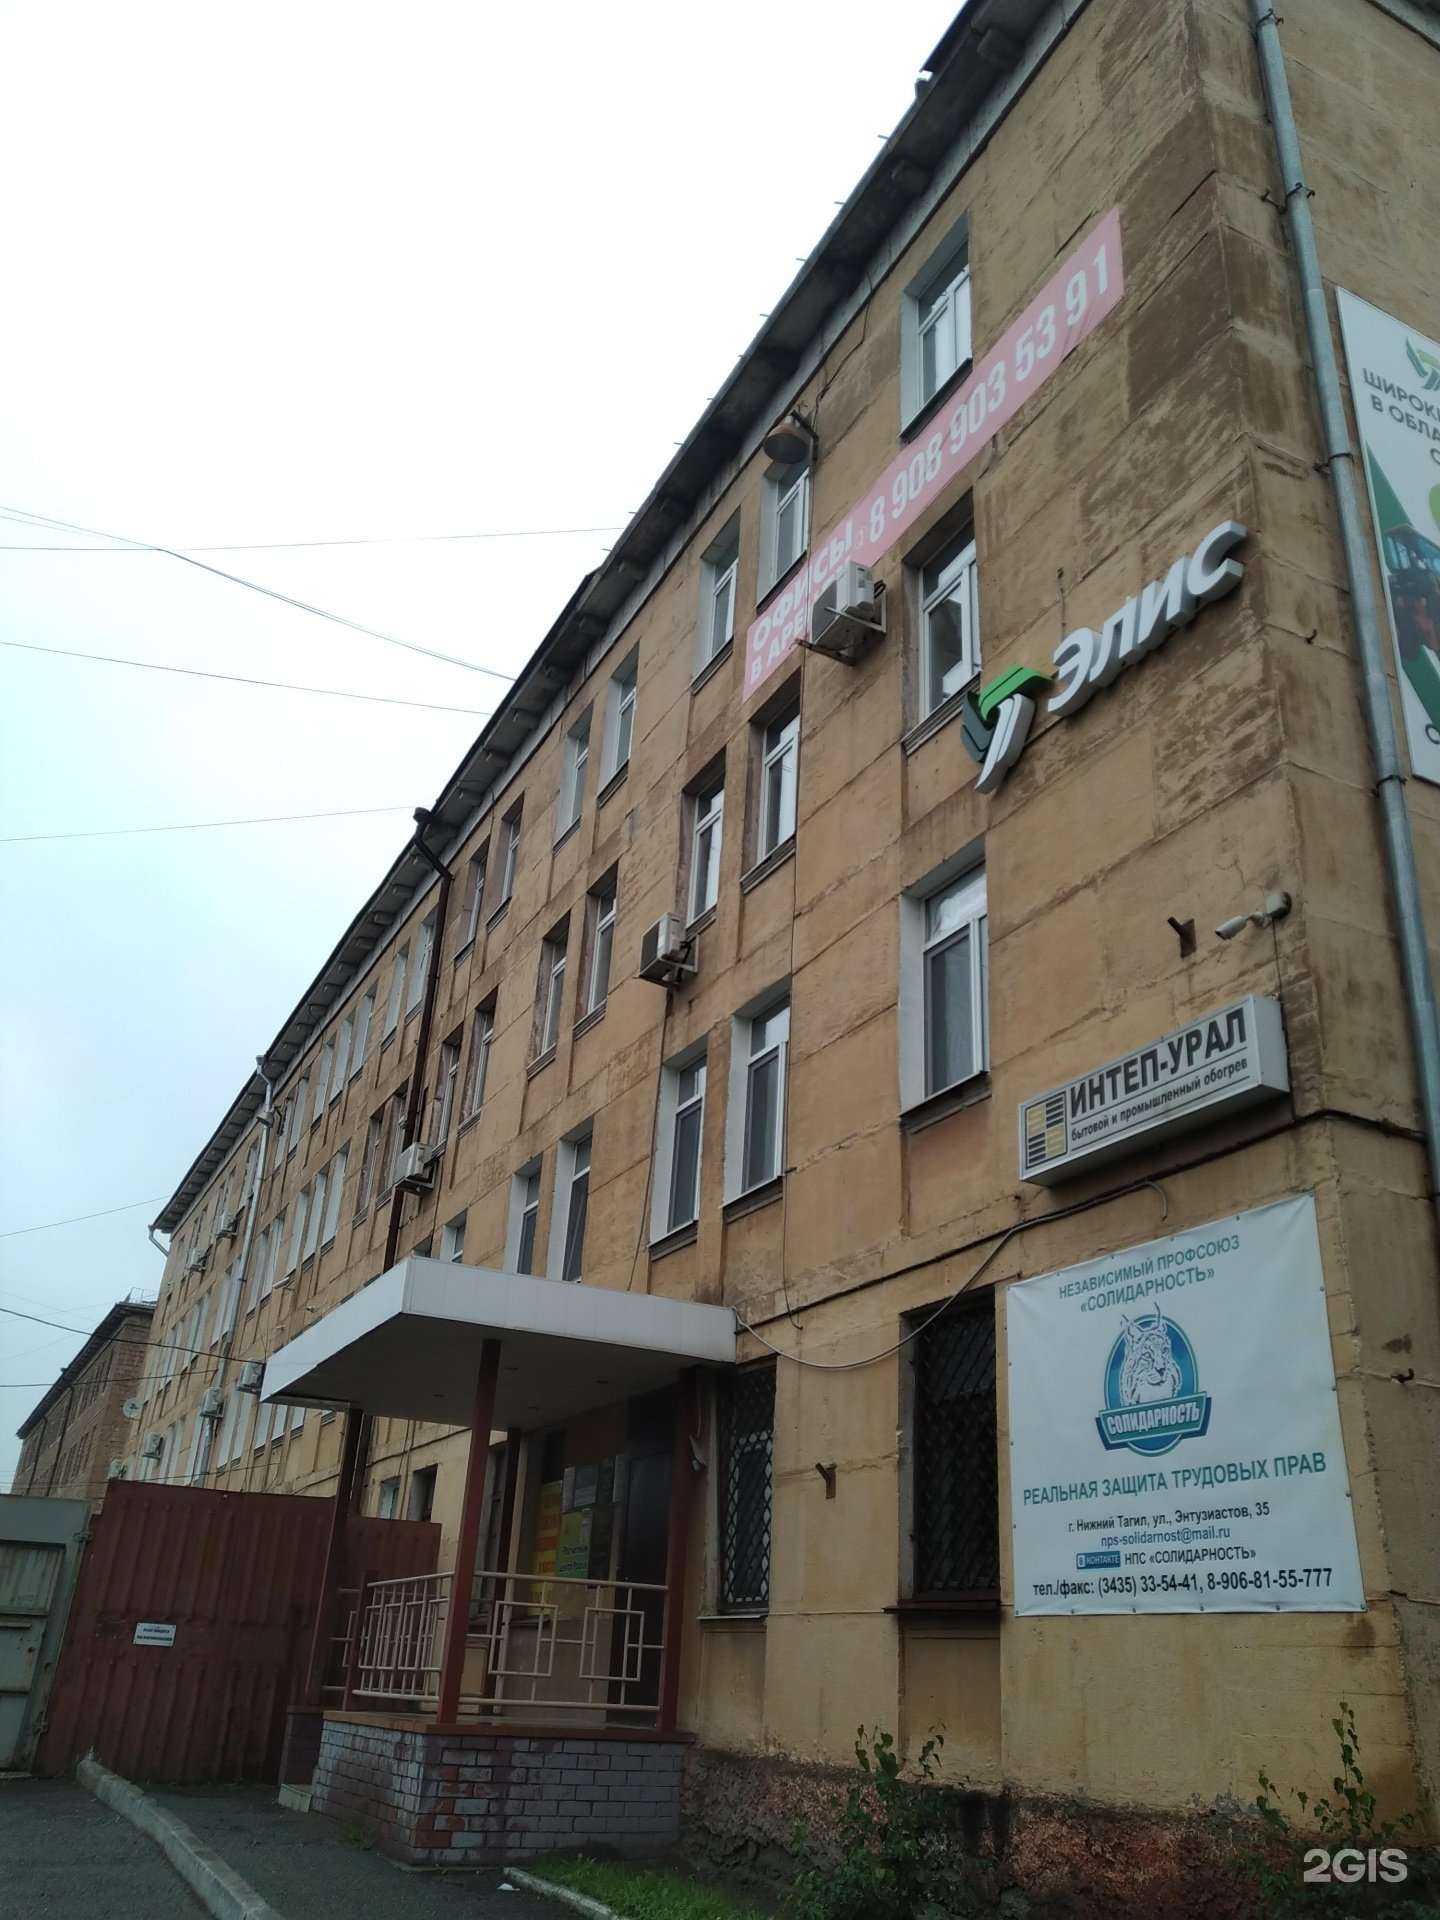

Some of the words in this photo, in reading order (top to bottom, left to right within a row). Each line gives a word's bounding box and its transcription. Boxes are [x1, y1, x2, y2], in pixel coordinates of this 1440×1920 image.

[868, 495, 886, 543] 8
[891, 432, 943, 519] 908
[950, 359, 1006, 455] 903
[1015, 304, 1056, 382] 53
[1371, 394, 1383, 413] В
[1047, 519, 1248, 716] ЭЛИС
[1070, 1007, 1247, 1118] ИНТЕП-УРАЛ
[1071, 1118, 1110, 1141] бытовой
[1111, 1115, 1118, 1124] и
[1120, 1076, 1201, 1123] промышленный
[1203, 1058, 1248, 1086] обогрев
[1059, 1257, 1155, 1299] НЕЗАВИСИМЫЙ
[1157, 1235, 1241, 1272] ПРОФСОЮЗ
[1080, 1267, 1215, 1313] «СОЛИДАРНОСТЬ»
[1107, 1401, 1201, 1435] СОЛИДАРНОСТЬ
[1023, 1481, 1099, 1506] РЕАЛЬНАЯ
[1102, 1471, 1168, 1497] ЗАЩИТА
[1172, 1459, 1269, 1491] ТРУДОВЫХ
[1274, 1452, 1327, 1478] ПРАВ
[1076, 1516, 1115, 1532] Нижний
[1118, 1514, 1150, 1530] Тагил,
[1175, 1505, 1253, 1525] Энтузиастов,
[1255, 1501, 1271, 1517] 35
[1101, 1526, 1231, 1549] nps-solidarnost@mail.ru
[1125, 1552, 1147, 1566] НПС
[1149, 1546, 1256, 1565] «СОЛИДАРНОСТЬ»
[1032, 1578, 1095, 1599] тел./факс:
[1098, 1575, 1138, 1598] (3435)
[1141, 1572, 1203, 1594] 33-54-41,
[1207, 1567, 1333, 1591] 8-906-81-55-777
